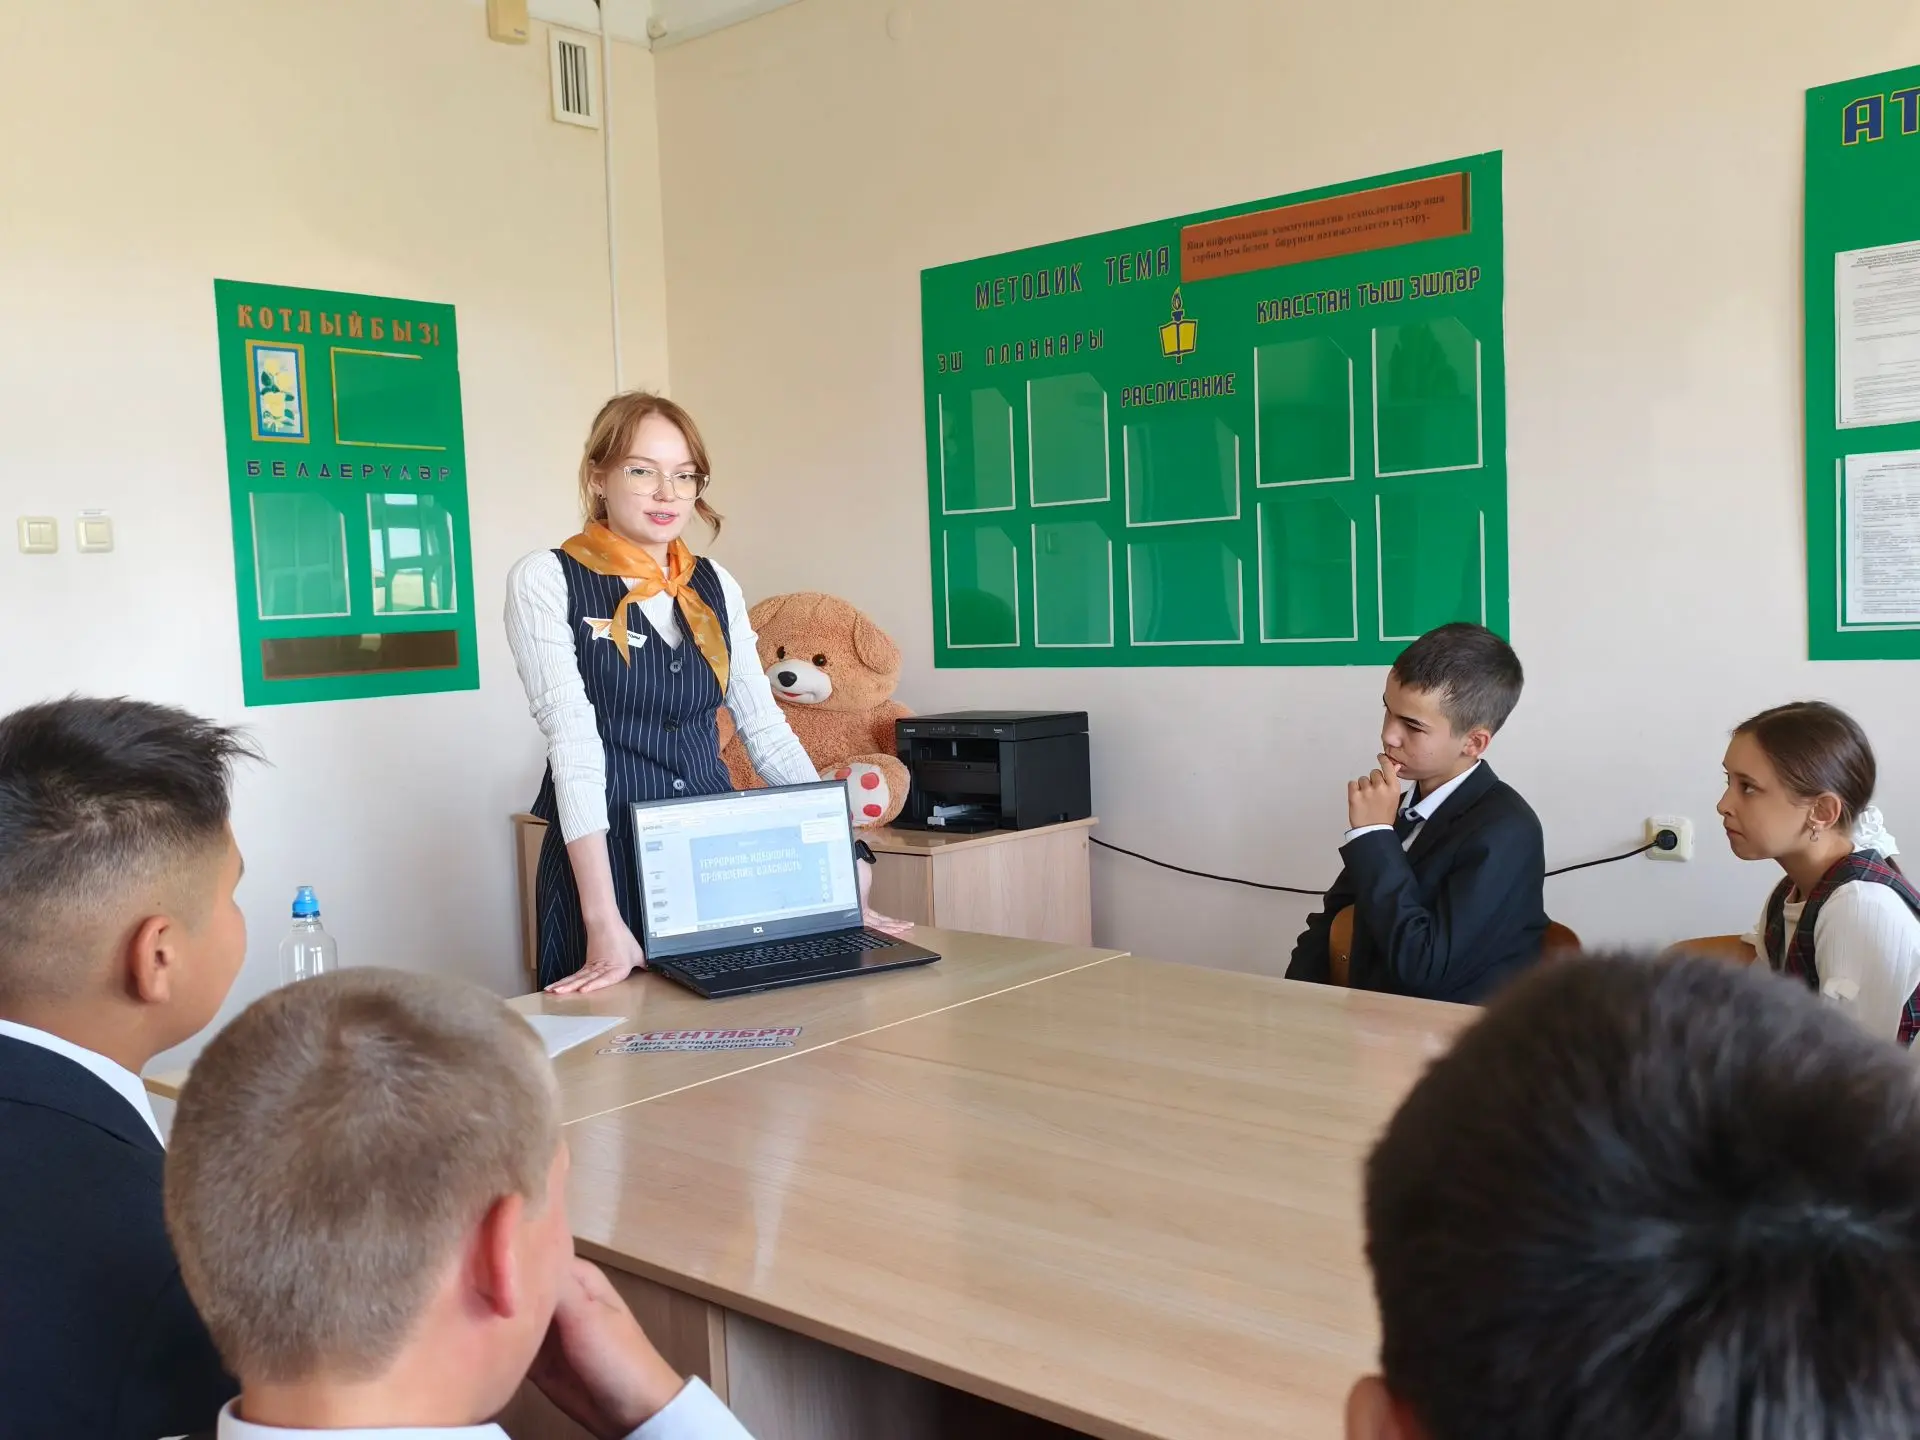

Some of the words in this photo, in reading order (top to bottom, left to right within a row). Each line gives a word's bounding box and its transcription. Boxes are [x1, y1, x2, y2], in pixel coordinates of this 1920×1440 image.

[975, 262, 1082, 311] МЕТОДИК
[1104, 245, 1170, 286] ТЕМА
[1256, 287, 1351, 324] КЛАССТАН
[1357, 278, 1404, 307] ТЫШ
[237, 303, 440, 346] КОТЛЫЙБЫЗ!
[938, 351, 963, 374] ЭШ
[985, 328, 1104, 367] ПЛАННАРЫ
[1121, 373, 1236, 408] РАСПИСАНИЕ
[642, 1028, 796, 1041] СЕНТЯБРЯ
[669, 1036, 774, 1045] солидарности
